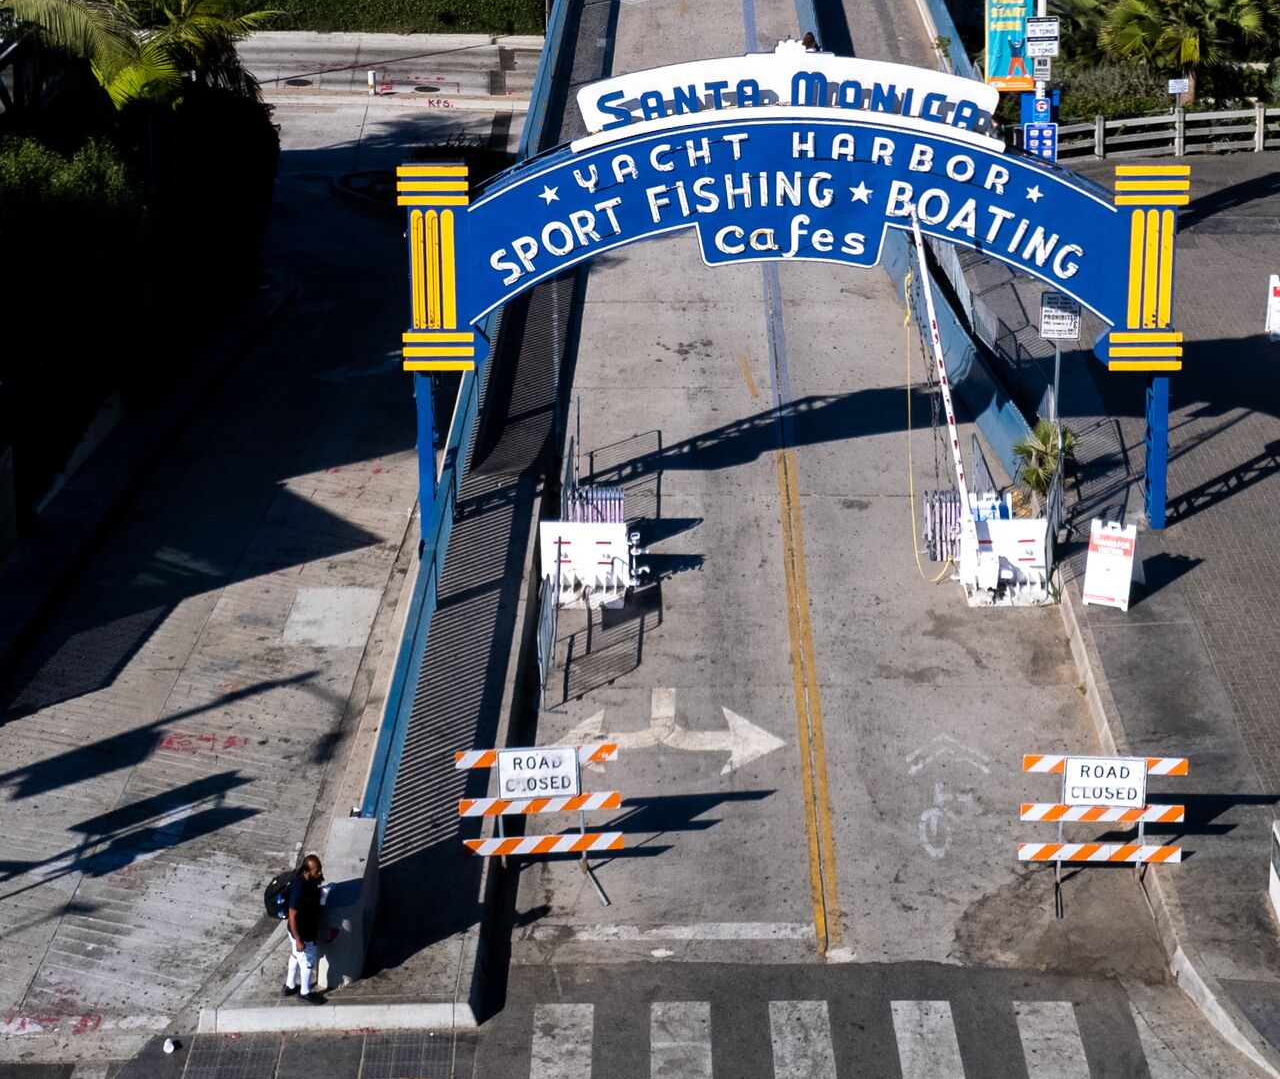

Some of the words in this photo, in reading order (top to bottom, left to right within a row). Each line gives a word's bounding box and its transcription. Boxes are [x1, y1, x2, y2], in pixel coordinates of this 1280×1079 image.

[990, 7, 1027, 18] START
[990, 20, 1022, 31] HERE
[1037, 59, 1048, 67] NO
[596, 78, 761, 132] SANTA
[790, 71, 982, 128] MONICA
[573, 132, 749, 194] YACHT
[792, 130, 1010, 196] HARBOR
[489, 196, 622, 286] SPORT
[645, 171, 834, 223] FISHING
[885, 179, 1087, 280] BOATING
[513, 756, 562, 771] ROAD
[1080, 764, 1131, 779] ROAD
[1071, 785, 1138, 801] CLOSED
